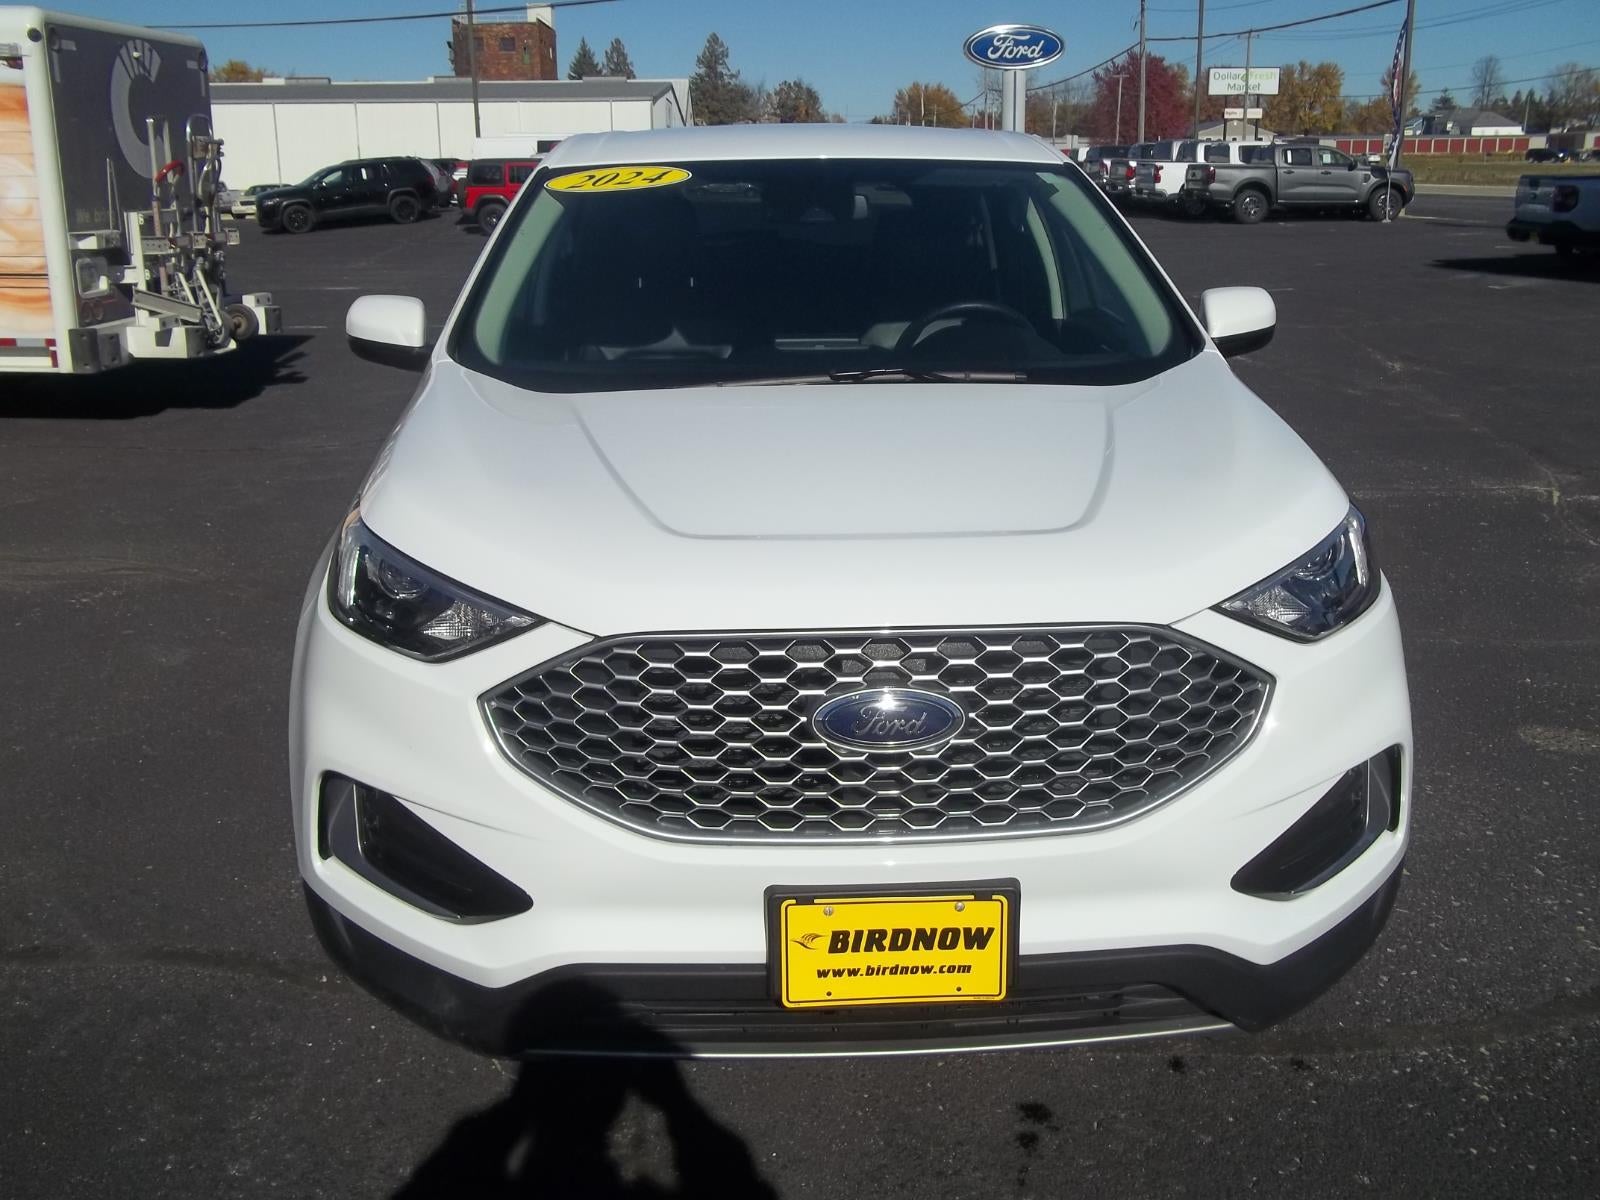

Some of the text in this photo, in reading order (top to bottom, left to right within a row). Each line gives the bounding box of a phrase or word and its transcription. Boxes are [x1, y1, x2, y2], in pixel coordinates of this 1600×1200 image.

[988, 34, 1045, 59] Ford
[1213, 71, 1240, 81] Dollar
[564, 169, 673, 189] 2024
[852, 703, 928, 736] Ford
[828, 926, 995, 954] BIRDNOW
[816, 963, 972, 979] www.birdnow.com
